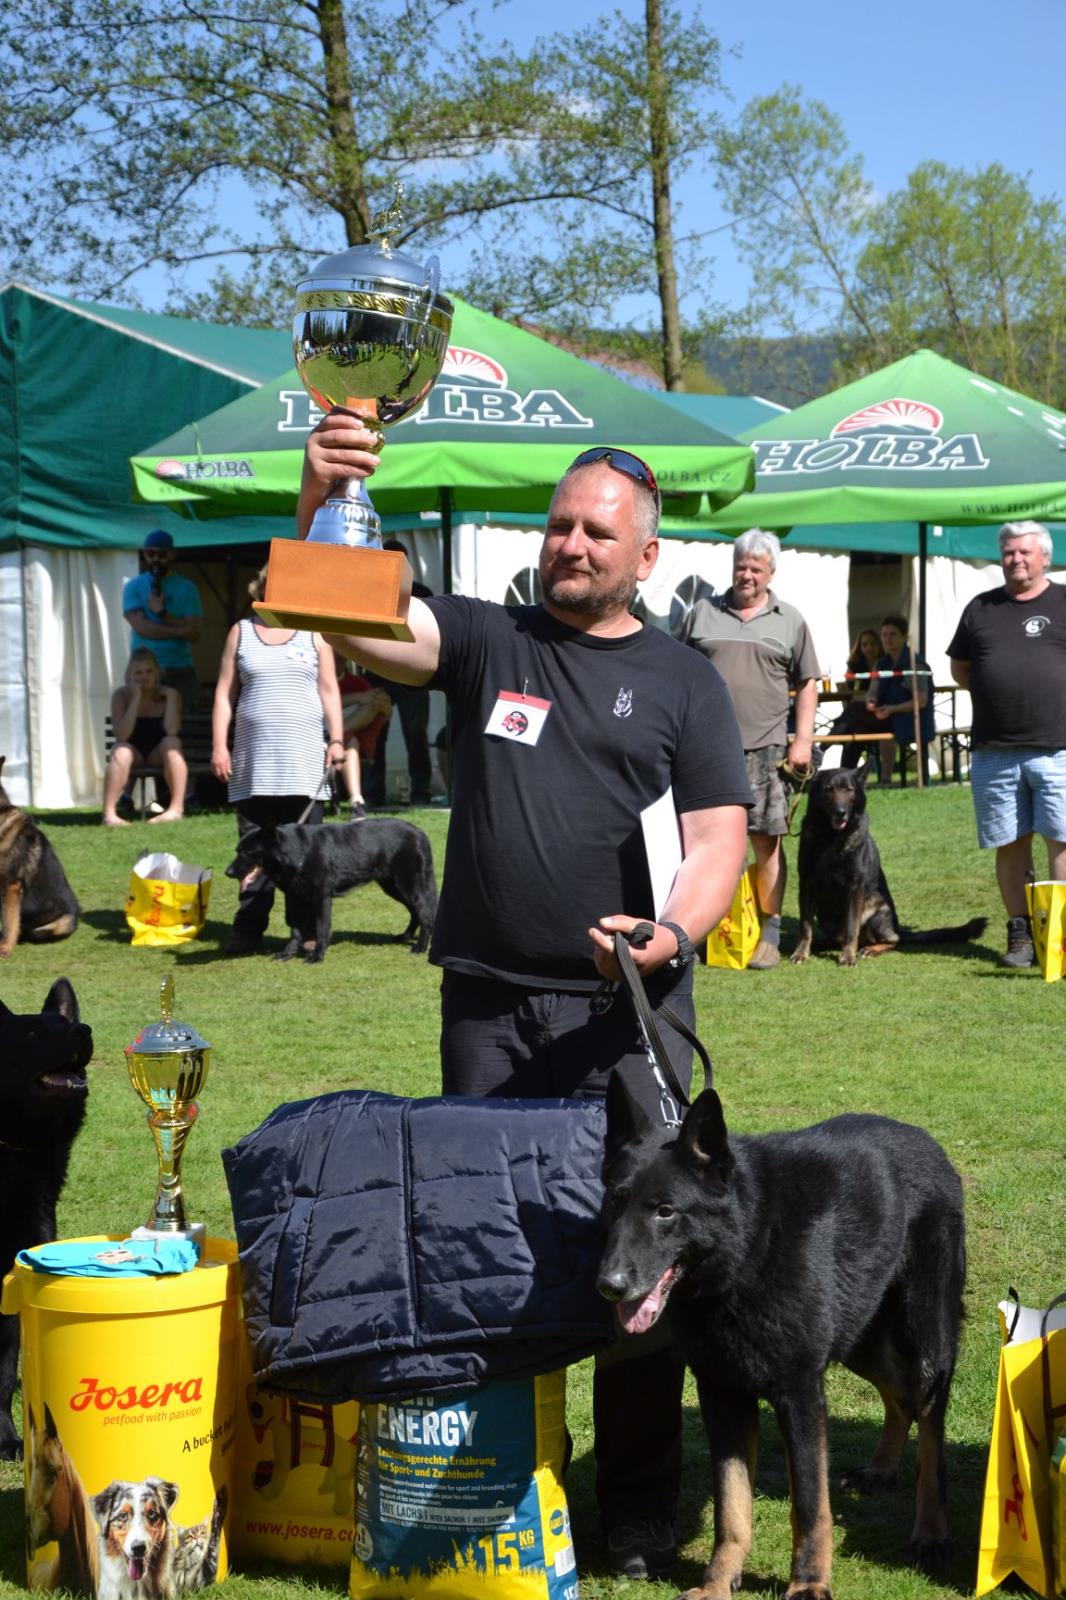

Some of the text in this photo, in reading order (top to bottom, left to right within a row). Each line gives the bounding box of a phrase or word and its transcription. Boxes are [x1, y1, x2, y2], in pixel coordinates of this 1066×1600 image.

[750, 433, 990, 475] HOLBA
[184, 459, 254, 479] HOLBA
[656, 469, 732, 482] OLBA.CZ
[69, 1377, 203, 1412] Josera
[103, 1406, 202, 1427] petfood with passion
[378, 1403, 478, 1447] ENERGY
[182, 1440, 191, 1453] A
[389, 1462, 413, 1475] Sport-
[414, 1468, 430, 1477] und
[431, 1468, 485, 1479] Zuchthunde
[449, 1456, 497, 1467] Ernährung
[381, 1502, 394, 1514] MIT
[396, 1505, 423, 1520] LACHS
[246, 1520, 353, 1542] www.josera.co
[478, 1529, 535, 1574] 15 KG
